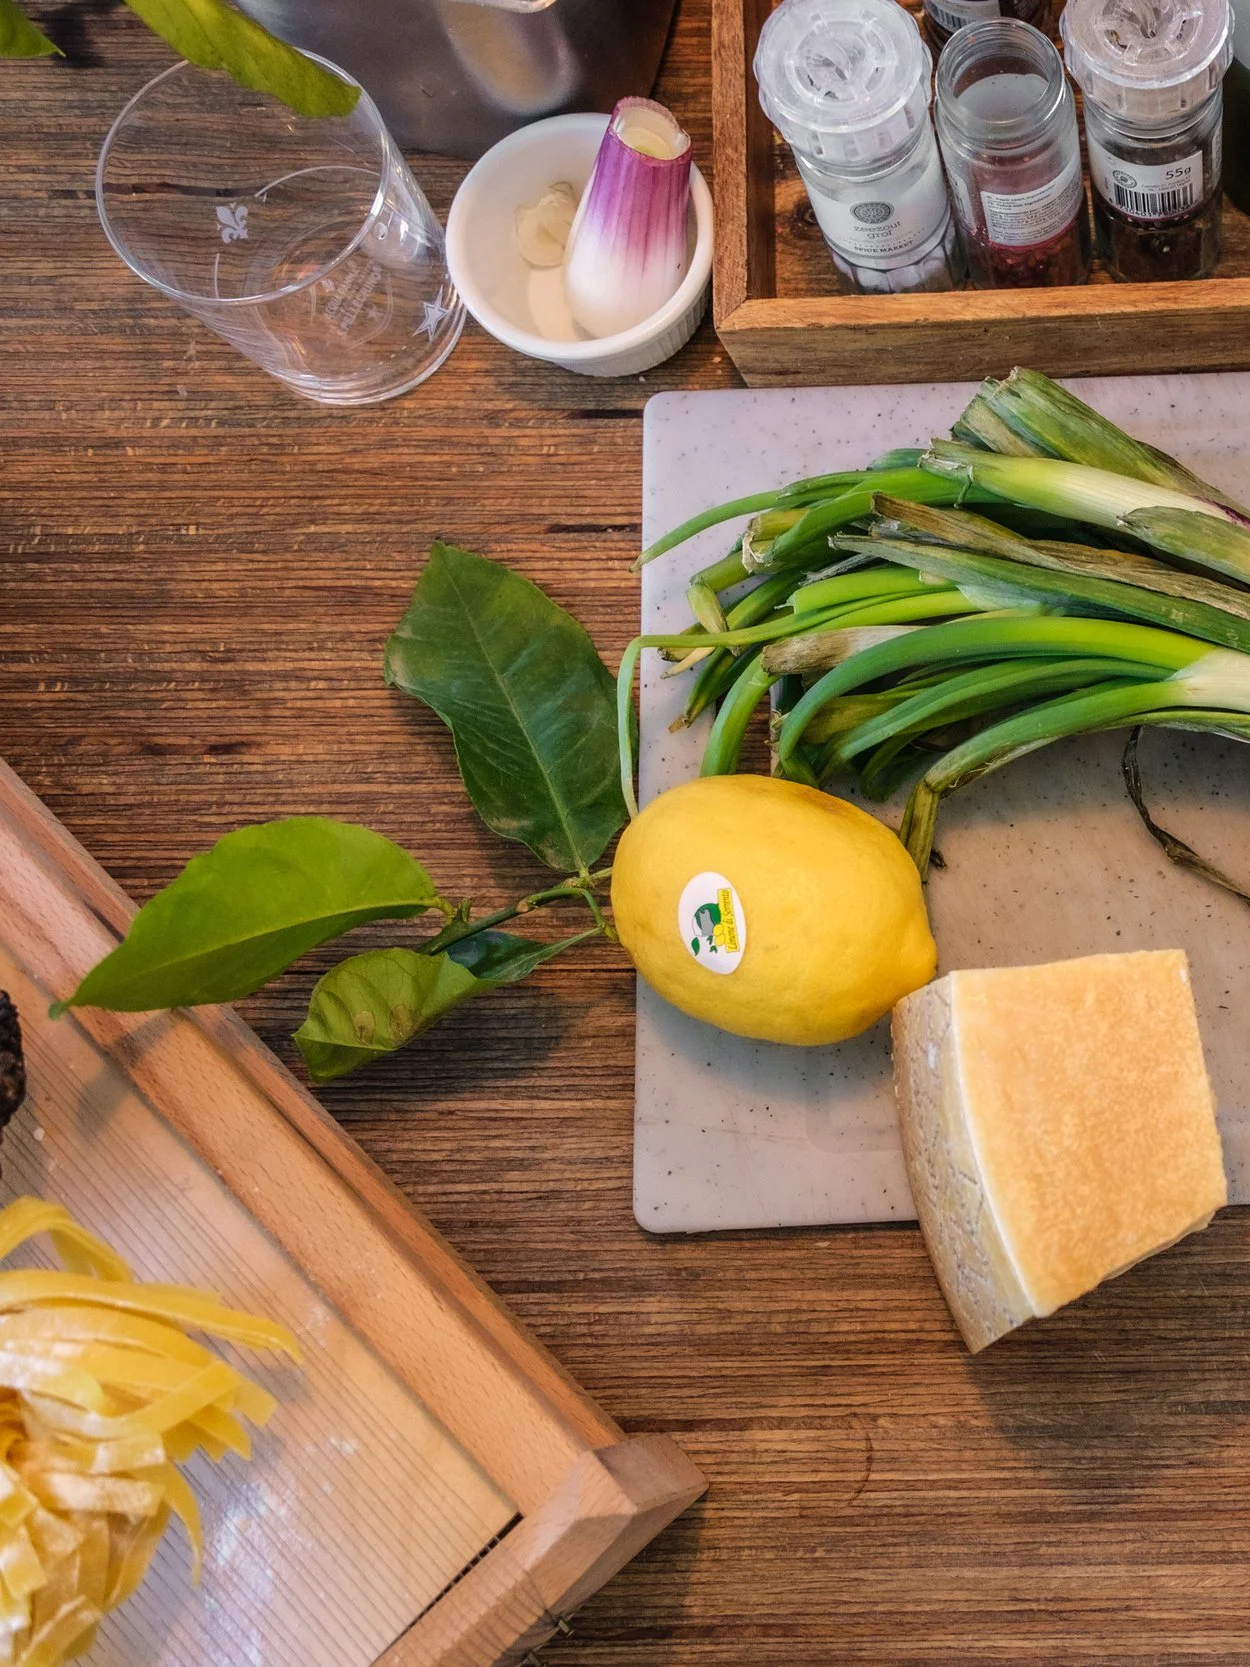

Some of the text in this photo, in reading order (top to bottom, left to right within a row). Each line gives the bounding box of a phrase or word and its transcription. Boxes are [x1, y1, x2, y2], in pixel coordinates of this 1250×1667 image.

[1165, 167, 1191, 180] 55g
[854, 221, 901, 233] zeezout
[867, 230, 893, 239] grof
[880, 240, 914, 252] MARKET
